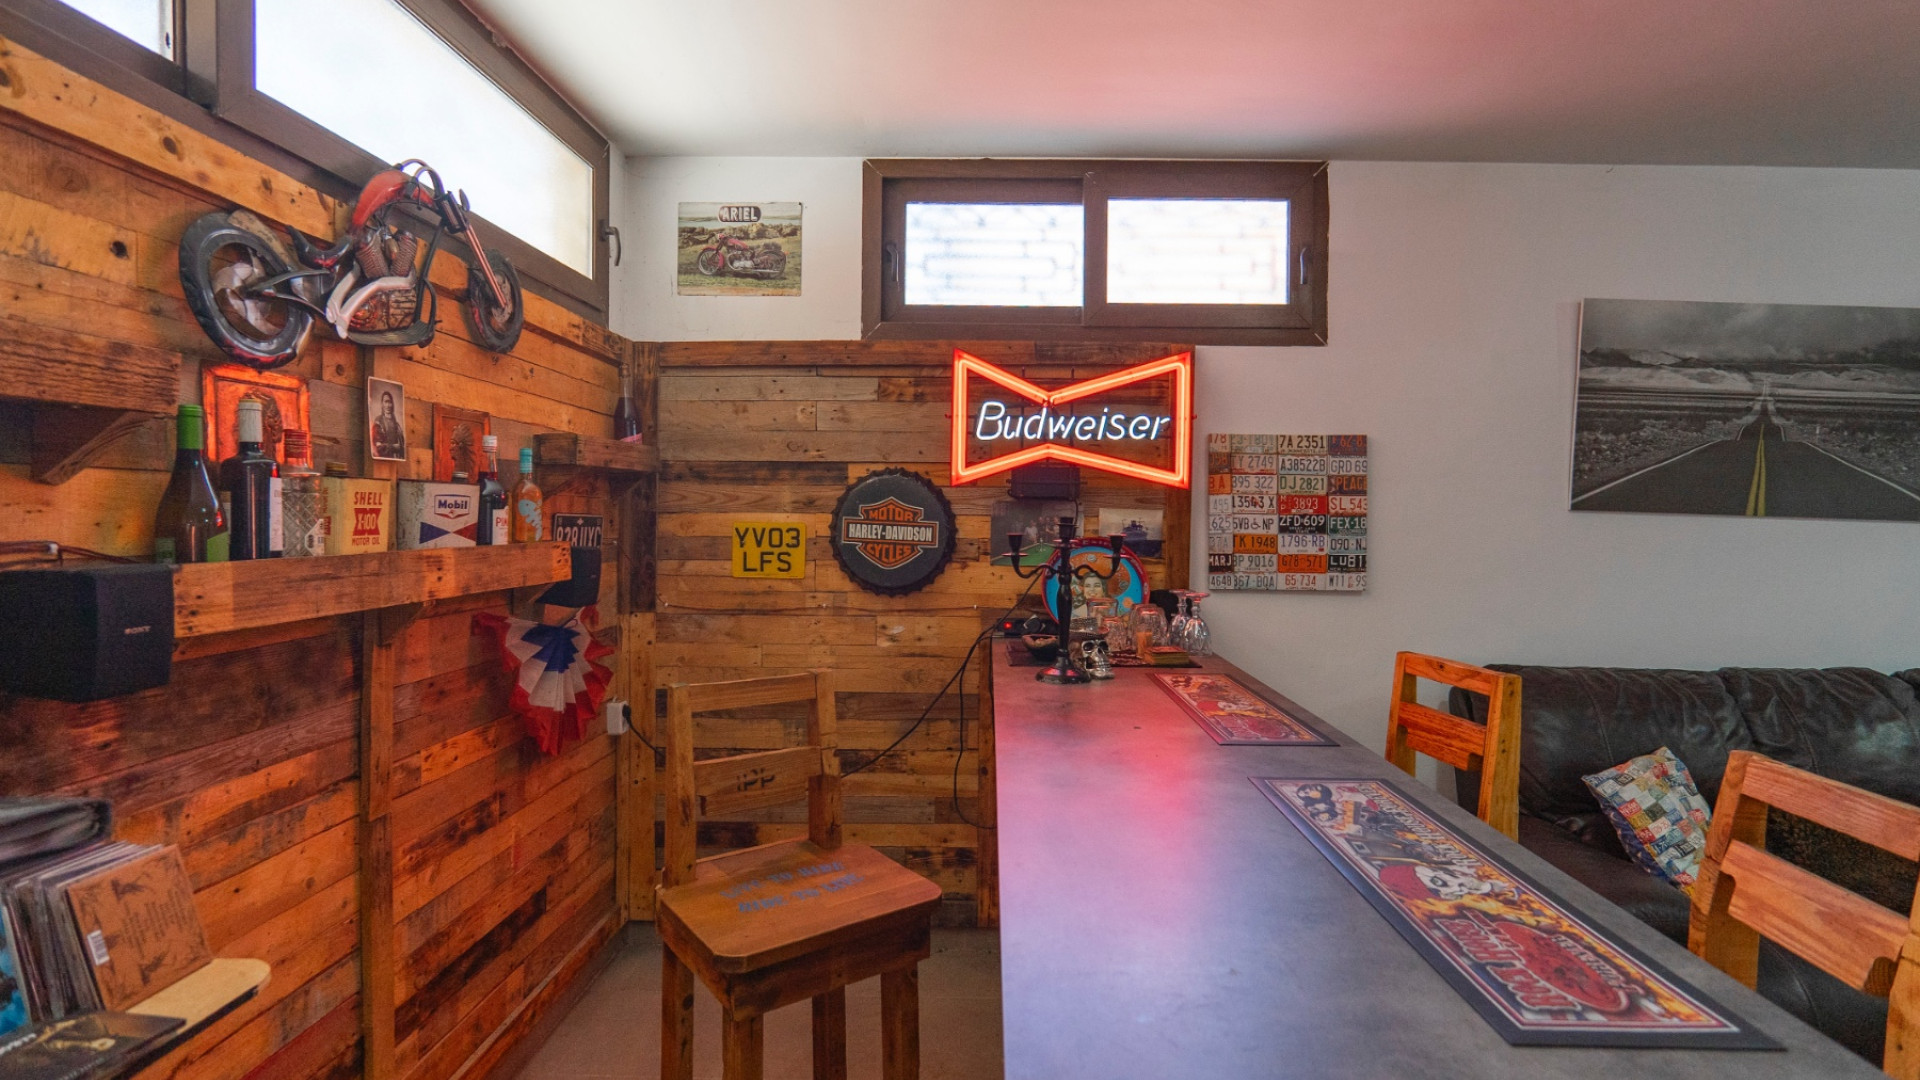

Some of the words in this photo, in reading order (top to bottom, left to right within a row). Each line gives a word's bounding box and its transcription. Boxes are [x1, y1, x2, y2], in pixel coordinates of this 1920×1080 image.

[721, 206, 758, 221] ARIEL
[976, 400, 1171, 441] Budweiser
[1279, 435, 1294, 448] 7A
[1297, 435, 1325, 449] 2351
[1248, 455, 1274, 468] 2749
[1331, 460, 1352, 473] GRD
[1254, 476, 1274, 489] 322
[1300, 477, 1325, 490] 2821
[353, 491, 383, 506] SHELL
[438, 500, 468, 510] Mobil
[1268, 495, 1275, 508] X
[1294, 497, 1318, 510] 3893
[868, 506, 914, 521] MOTOR
[735, 527, 800, 548] YV03
[848, 523, 933, 543] HARLEY-DAVIDSON
[352, 537, 370, 546] MOTOR
[372, 536, 380, 545] OIL
[1251, 536, 1276, 548] 1948
[865, 544, 912, 561] CYCLES
[743, 552, 792, 573] LFS
[1247, 555, 1274, 568] 9016
[1285, 575, 1297, 586] 65
[1300, 574, 1316, 587] 734
